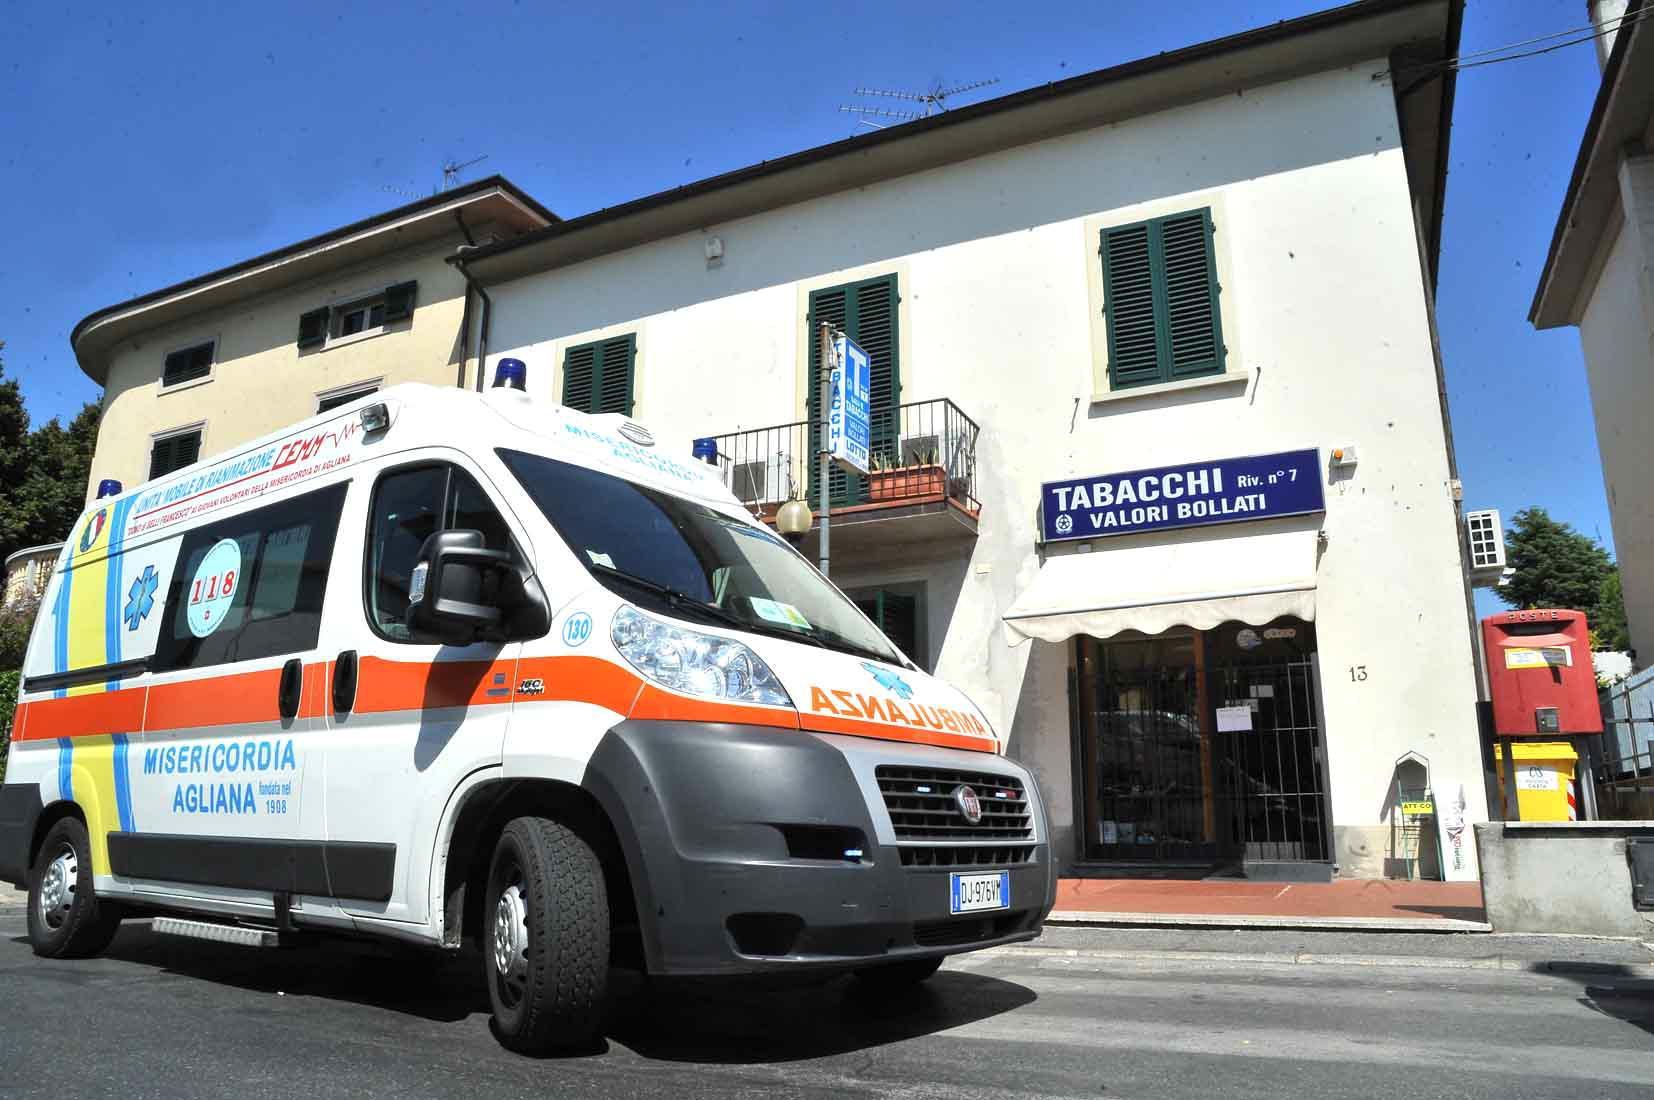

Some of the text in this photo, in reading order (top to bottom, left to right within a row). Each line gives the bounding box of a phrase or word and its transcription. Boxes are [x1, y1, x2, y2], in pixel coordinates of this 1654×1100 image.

[846, 439, 867, 460] LOTTO
[207, 449, 277, 488] RIANIMAZIONE
[219, 488, 251, 506] VOLONTARI
[250, 481, 269, 494] DELLA
[269, 469, 313, 488] MISERICORDIA
[313, 464, 321, 474] DI
[322, 453, 351, 470] AGLIANA
[1052, 468, 1223, 512] TABACCHI
[1237, 474, 1264, 488] Riv.
[1288, 469, 1297, 482] 7
[1089, 493, 1266, 529] VALORI BOLLATI
[191, 570, 235, 603] 118
[566, 618, 589, 640] 130
[1507, 611, 1558, 621] POSTE
[1349, 665, 1368, 682] 13
[144, 739, 296, 775] MISERICORDIA
[173, 783, 257, 814] AGLIANA
[266, 799, 287, 815] 1908
